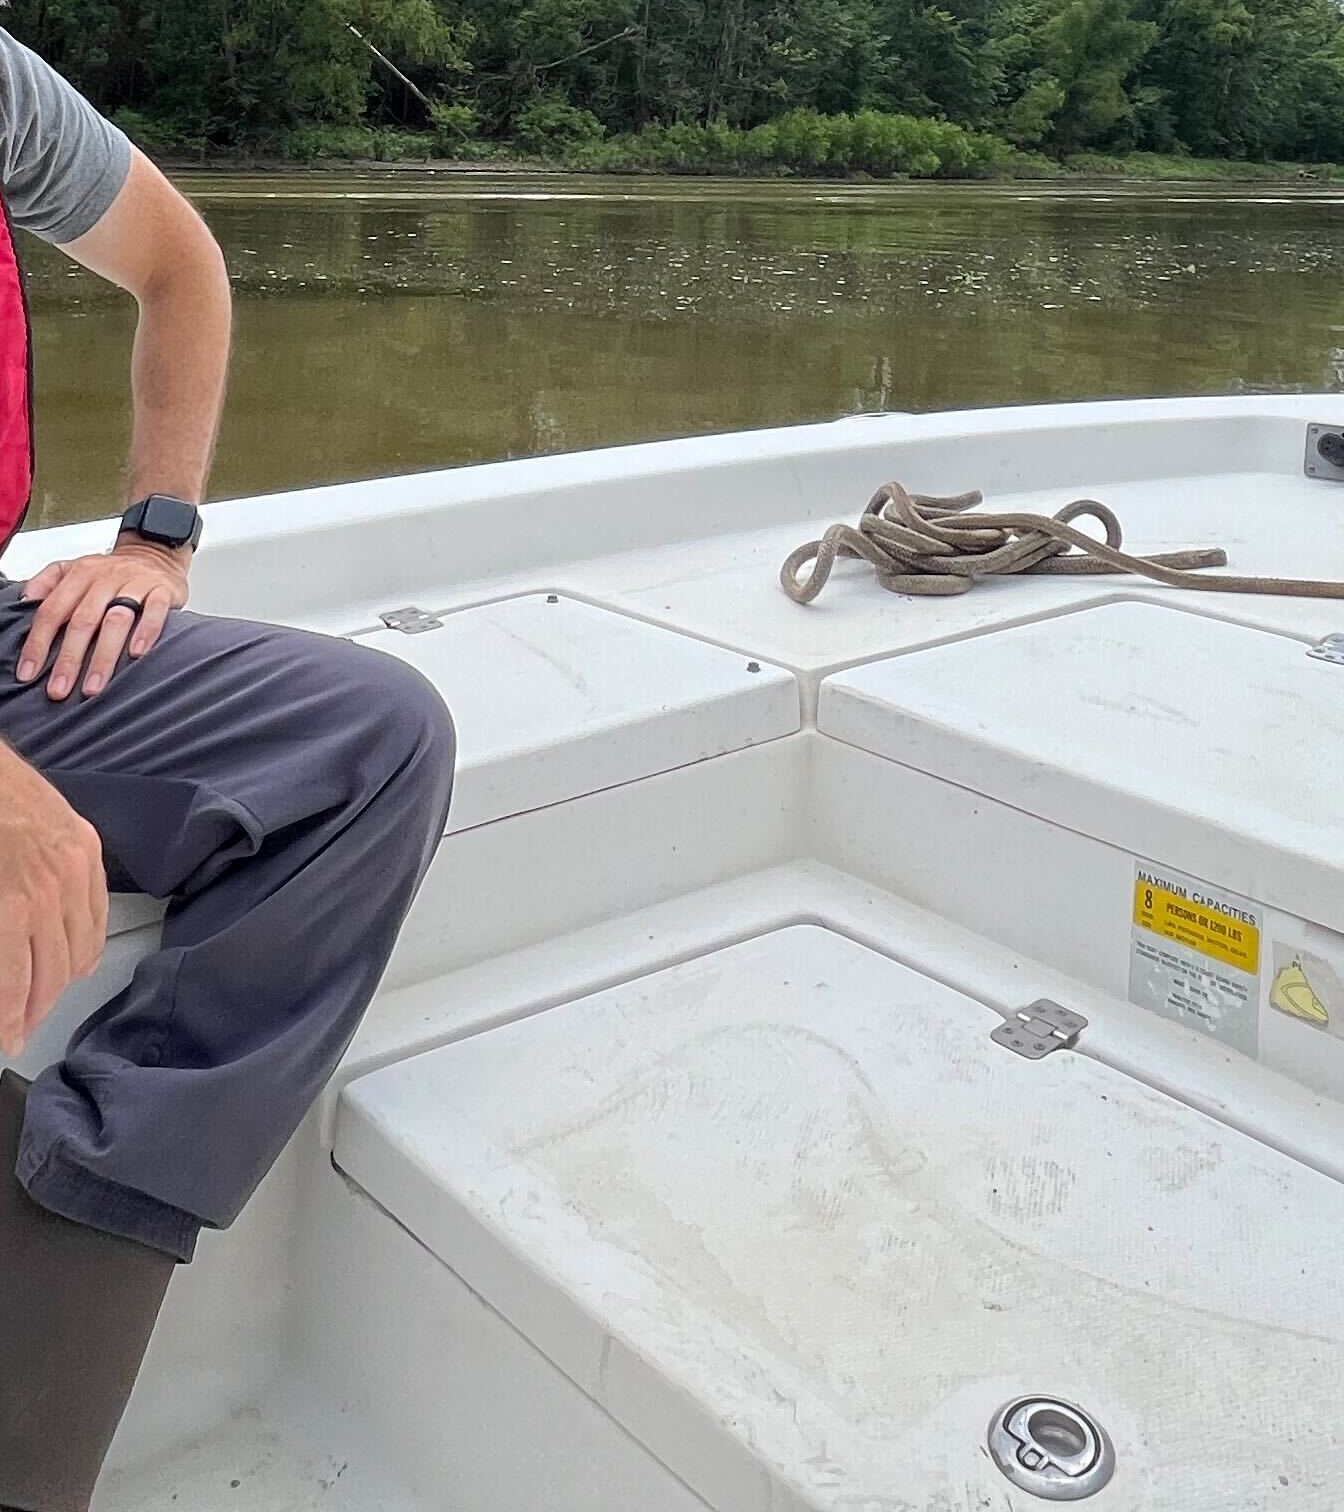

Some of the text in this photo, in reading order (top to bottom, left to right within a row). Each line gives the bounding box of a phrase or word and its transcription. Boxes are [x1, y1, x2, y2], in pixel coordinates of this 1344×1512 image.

[1138, 870, 1257, 926] MAXIMUM CAPACITIES
[1144, 889, 1153, 909] 8
